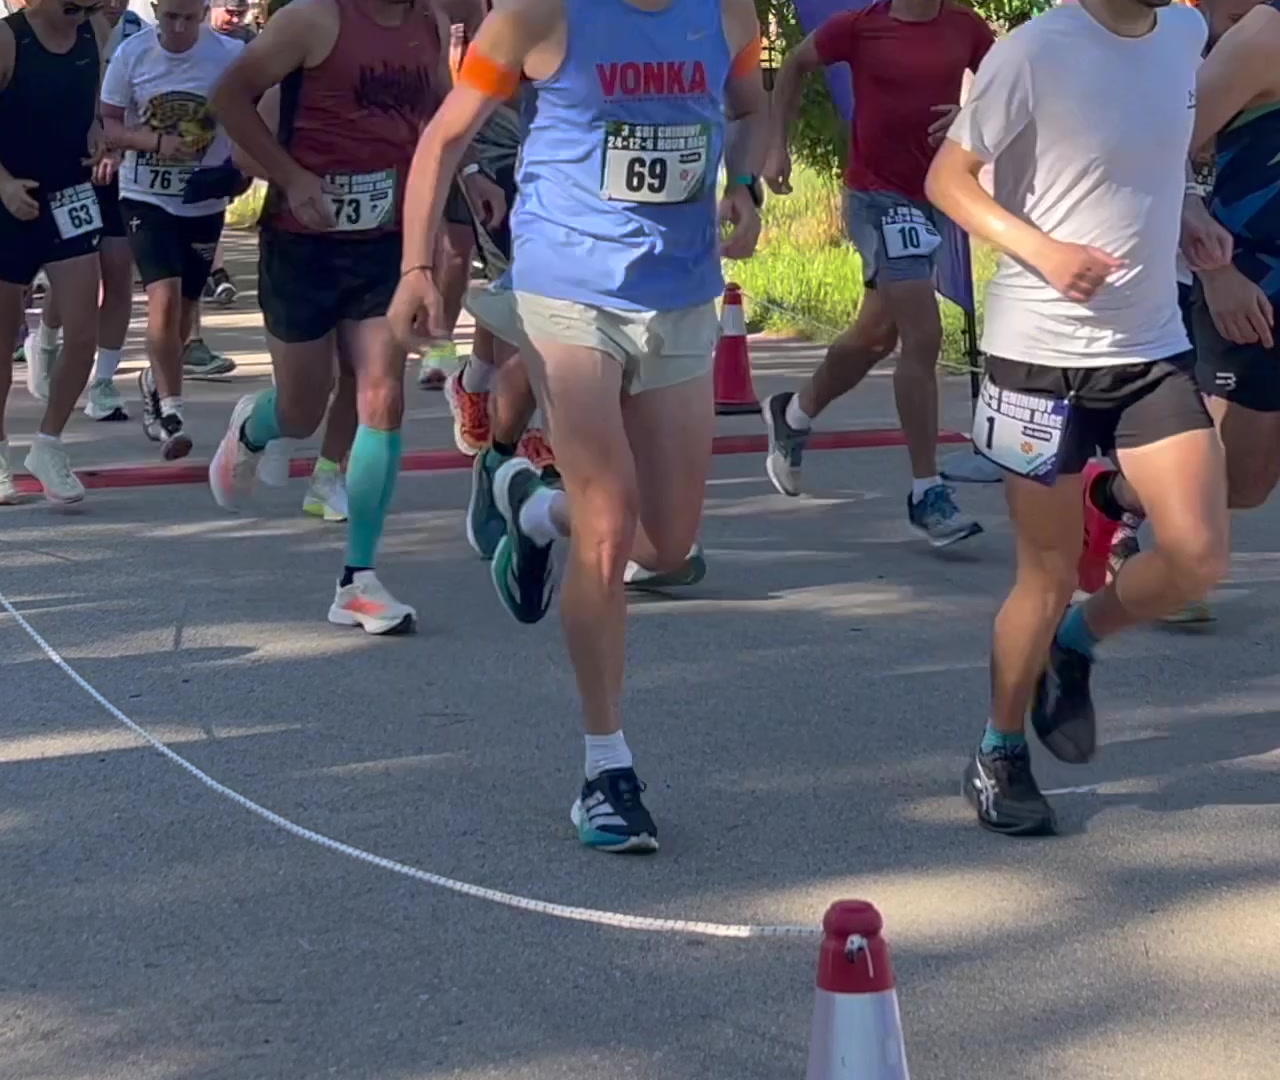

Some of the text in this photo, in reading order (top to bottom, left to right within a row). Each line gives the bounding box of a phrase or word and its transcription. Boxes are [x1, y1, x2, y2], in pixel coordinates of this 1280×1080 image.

[595, 60, 707, 97] VONKA
[149, 169, 172, 189] 76
[625, 156, 668, 194] 69
[68, 204, 94, 229] 63
[331, 198, 361, 224] 73
[897, 226, 921, 250] 10
[1001, 389, 1055, 414] CHINMOY
[1033, 411, 1064, 429] RACE
[986, 416, 997, 450] 1
